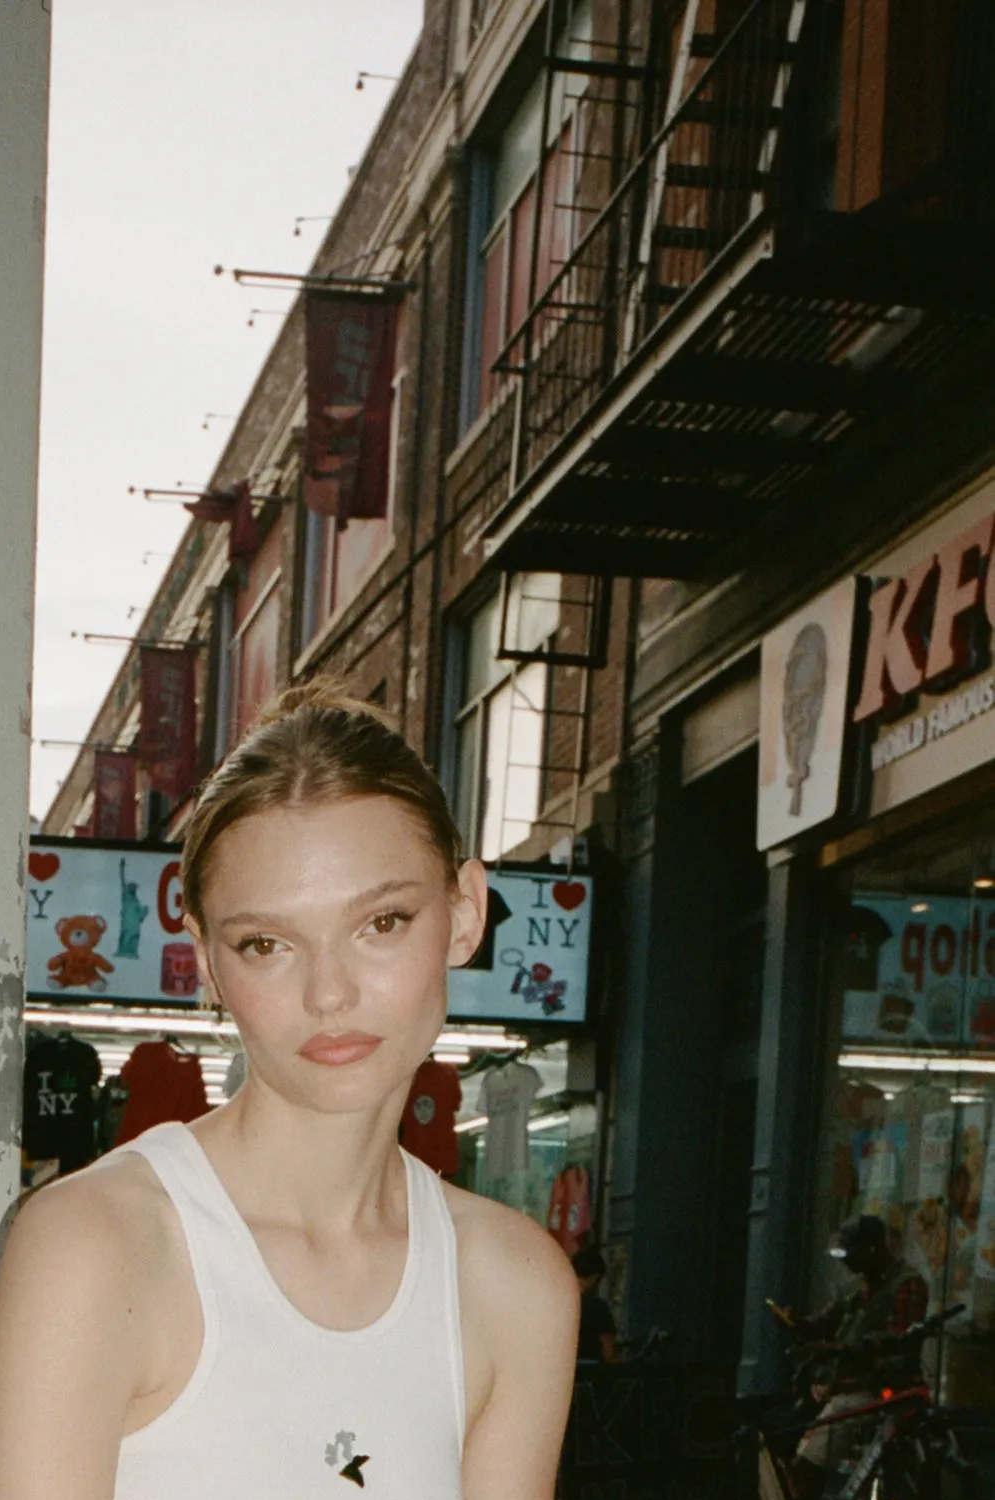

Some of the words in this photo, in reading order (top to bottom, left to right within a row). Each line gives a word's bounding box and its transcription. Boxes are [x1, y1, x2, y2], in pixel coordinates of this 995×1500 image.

[853, 512, 995, 723] KF
[531, 877, 549, 909] I
[527, 916, 581, 948] NY
[37, 1072, 52, 1094] I
[38, 1094, 78, 1117] NY
